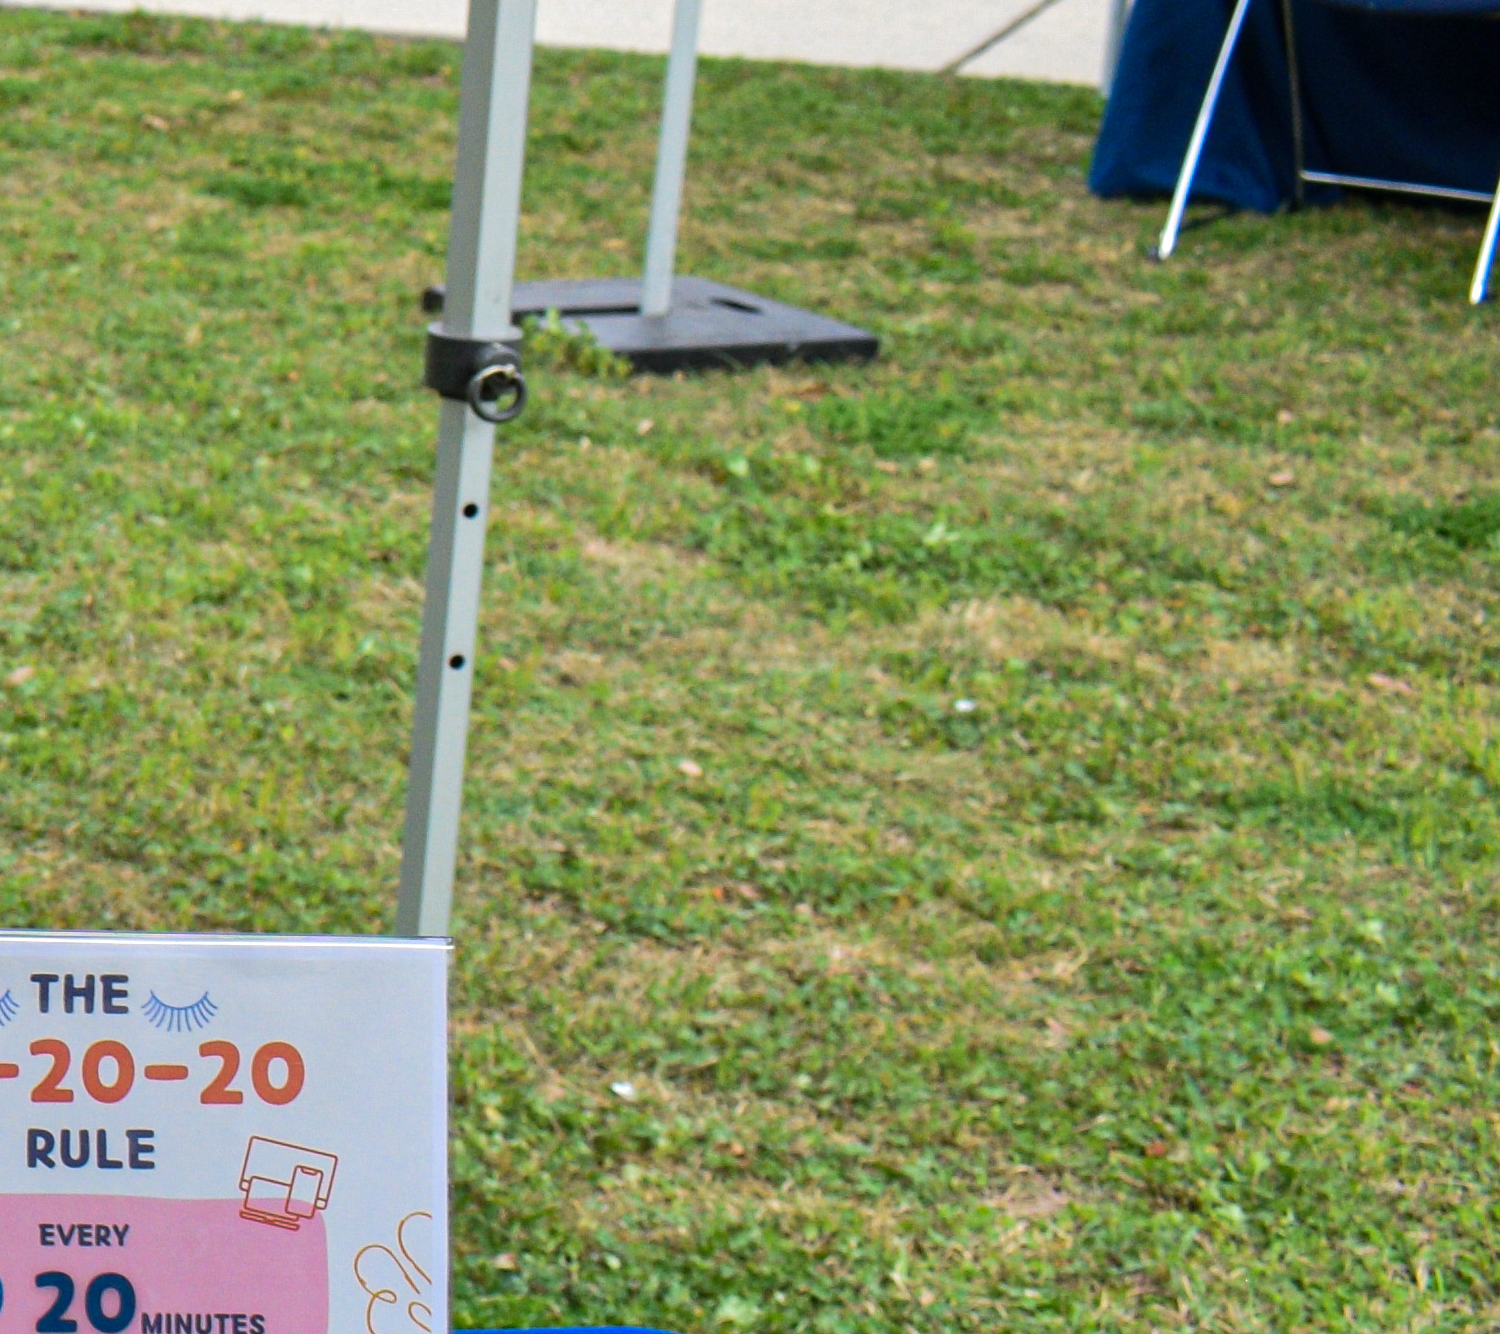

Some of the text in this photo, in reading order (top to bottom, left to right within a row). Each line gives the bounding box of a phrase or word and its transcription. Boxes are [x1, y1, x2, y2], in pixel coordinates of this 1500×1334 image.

[30, 973, 130, 1015] THE
[26, 1128, 156, 1170] RULE
[38, 1222, 130, 1247] EVERY
